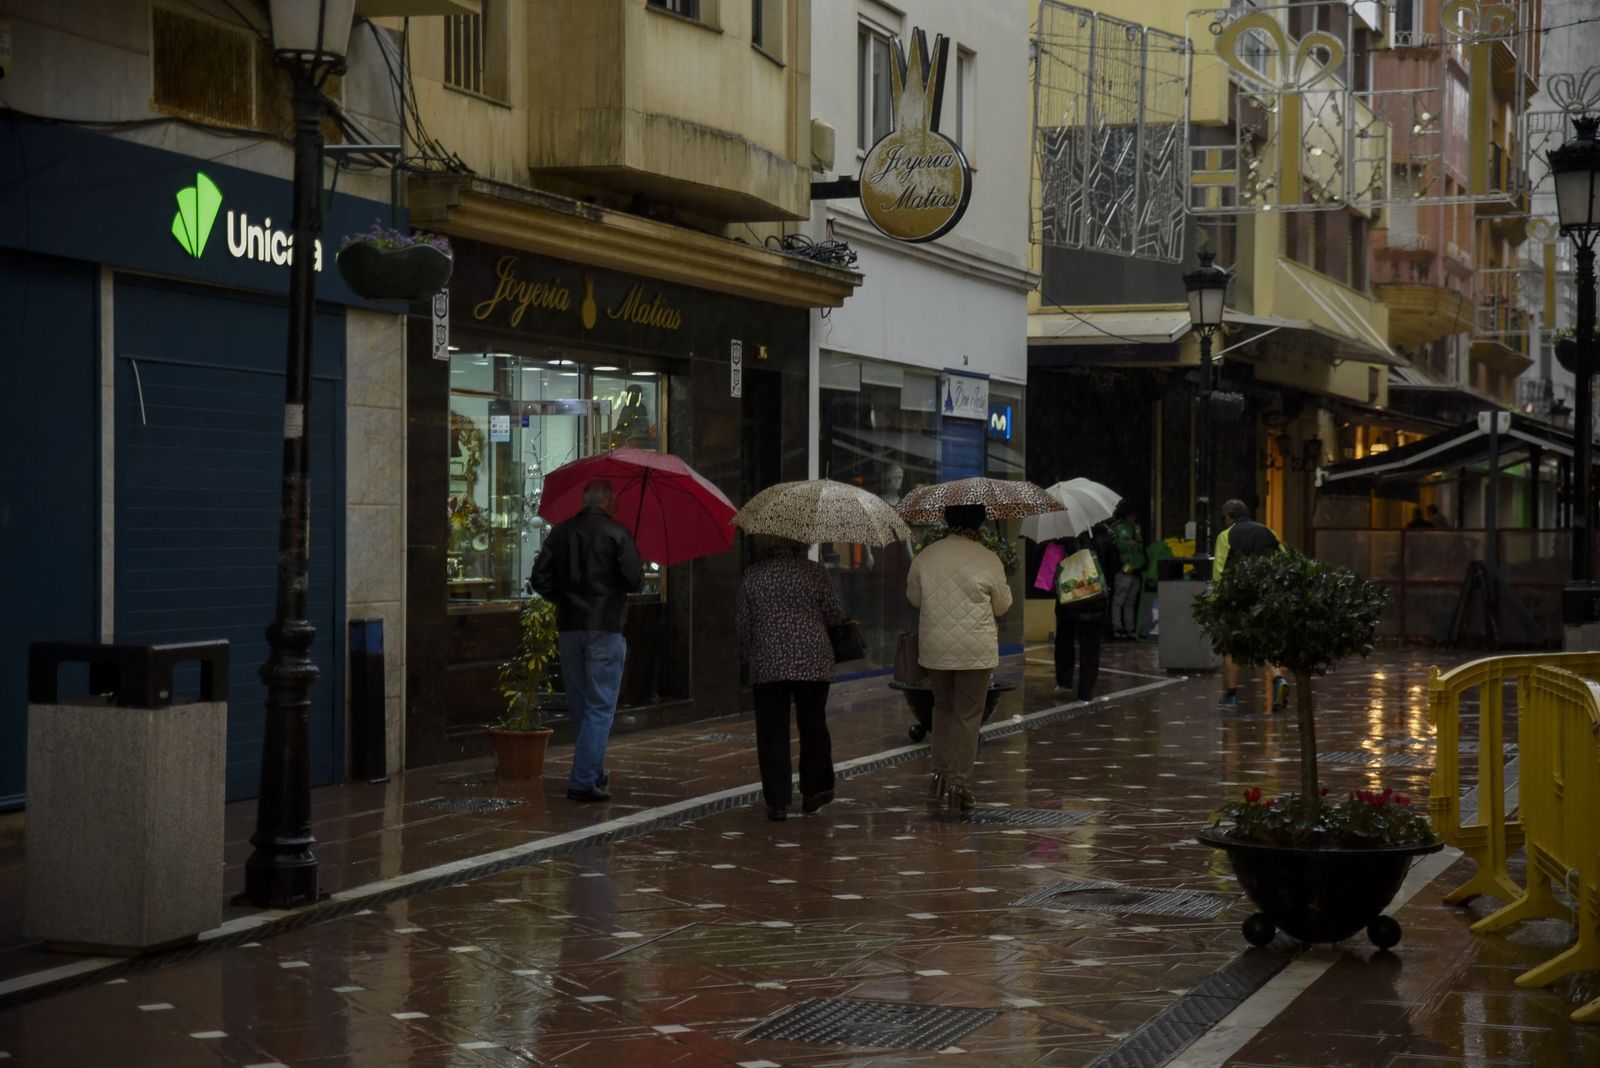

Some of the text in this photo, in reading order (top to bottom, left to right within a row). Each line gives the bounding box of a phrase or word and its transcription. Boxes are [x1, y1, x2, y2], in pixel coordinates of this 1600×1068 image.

[870, 143, 954, 185] Joyeria
[880, 184, 957, 211] Matias
[473, 255, 683, 330] Joyeria Matias
